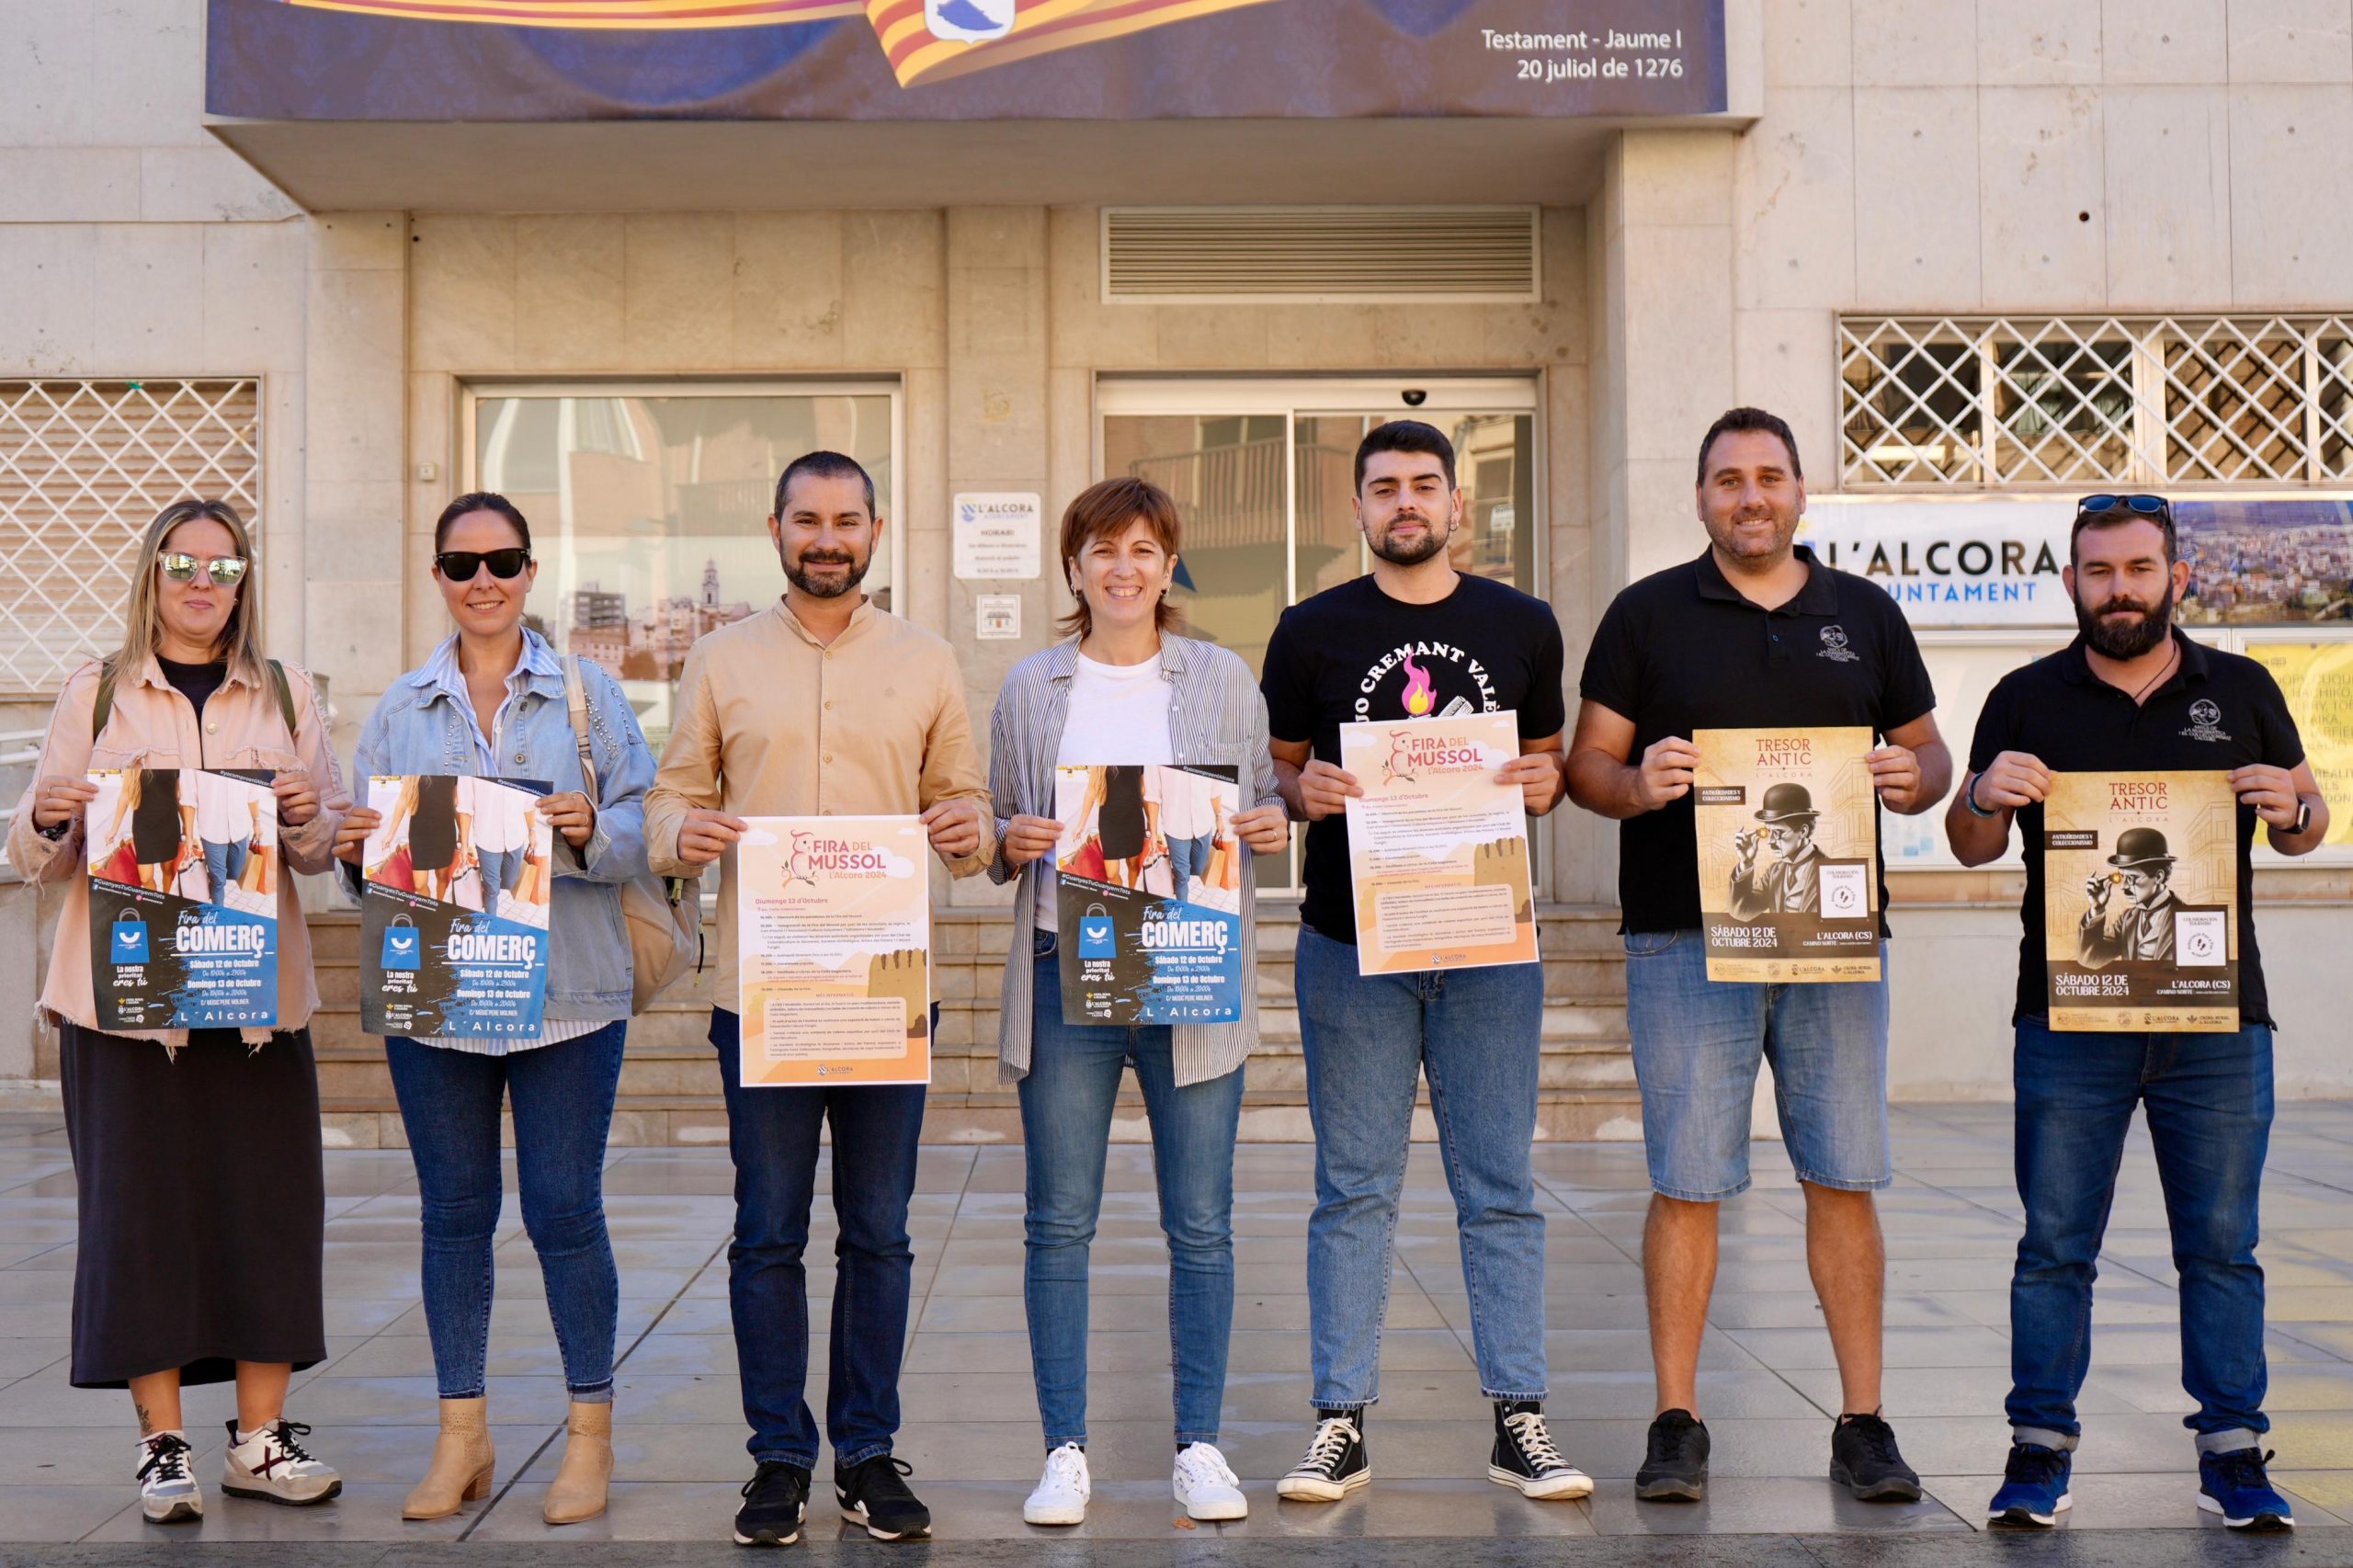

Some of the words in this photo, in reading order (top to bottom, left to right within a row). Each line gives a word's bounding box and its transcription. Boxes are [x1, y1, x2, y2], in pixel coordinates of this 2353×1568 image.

[1481, 28, 1587, 49] Testament
[1605, 28, 1671, 49] Jaume
[1677, 28, 1681, 49] I
[1517, 59, 1542, 78] 20
[1545, 57, 1597, 84] juliol
[1602, 58, 1628, 77] de
[1634, 58, 1684, 77] 1276
[978, 504, 1035, 513] L'ALCORA
[1829, 540, 2061, 576] L'ALCORA
[1887, 582, 2038, 603] UNTAMENT
[1360, 642, 1465, 693] CREMANT
[1468, 659, 1500, 713] VALÈ
[1412, 737, 1447, 751] FIRA
[1449, 737, 1470, 747] DEL
[1756, 738, 1811, 752] TRESOR
[1407, 748, 1483, 767] MUSSOL
[1756, 753, 1812, 766] ANTIC
[1462, 765, 1484, 773] 2024
[2109, 782, 2167, 796] TRESOR
[2109, 796, 2168, 810] ANTIC
[813, 839, 849, 853] FIRA
[852, 841, 873, 851] DEL
[808, 854, 887, 870] MUSSOL
[865, 870, 887, 879] 2024
[178, 910, 199, 926] Fira
[201, 911, 217, 925] del
[1142, 905, 1165, 921] Fira
[1166, 906, 1181, 920] del
[449, 918, 472, 934] Fira
[473, 920, 490, 934] del
[1711, 924, 1750, 938] SÁBADO
[1751, 927, 1762, 938] 12
[1763, 927, 1777, 937] DE
[176, 924, 265, 959] COMERÇ
[1141, 920, 1228, 955] COMERÇ
[1711, 937, 1752, 948] OCTUBRE
[1752, 937, 1778, 948] 2024
[1817, 932, 1855, 941] L'ALCORA
[1855, 931, 1872, 940] (CS)
[447, 934, 536, 970] COMERÇ
[189, 960, 214, 969] Sábado
[215, 960, 223, 968] 12
[223, 960, 233, 968] de
[233, 959, 259, 968] Octubre
[1155, 955, 1179, 964] Sábado
[1180, 955, 1188, 964] 12
[1188, 955, 1197, 963] de
[1198, 955, 1223, 963] Octubre
[460, 969, 483, 978] Sábado
[485, 970, 493, 978] 12
[494, 970, 502, 978] de
[504, 970, 529, 978] Octubre
[1153, 975, 1181, 984] Domingo
[1182, 975, 1189, 983] 13
[1190, 975, 1199, 983] de
[1199, 975, 1225, 983] Octubre
[2055, 971, 2099, 986] SÁBADO
[2101, 975, 2112, 986] 12
[2113, 975, 2128, 986] DE
[188, 980, 216, 989] Domingo
[217, 980, 224, 988] 13
[235, 979, 261, 988] Octubre
[2055, 985, 2101, 996] OCTUBRE
[2101, 985, 2130, 996] 2024
[2172, 980, 2211, 989] L'ALCORA
[2211, 980, 2231, 989] (CS)
[457, 990, 485, 998] Domingo
[487, 990, 494, 998] 13
[495, 990, 504, 998] de
[505, 990, 530, 998] Octubre
